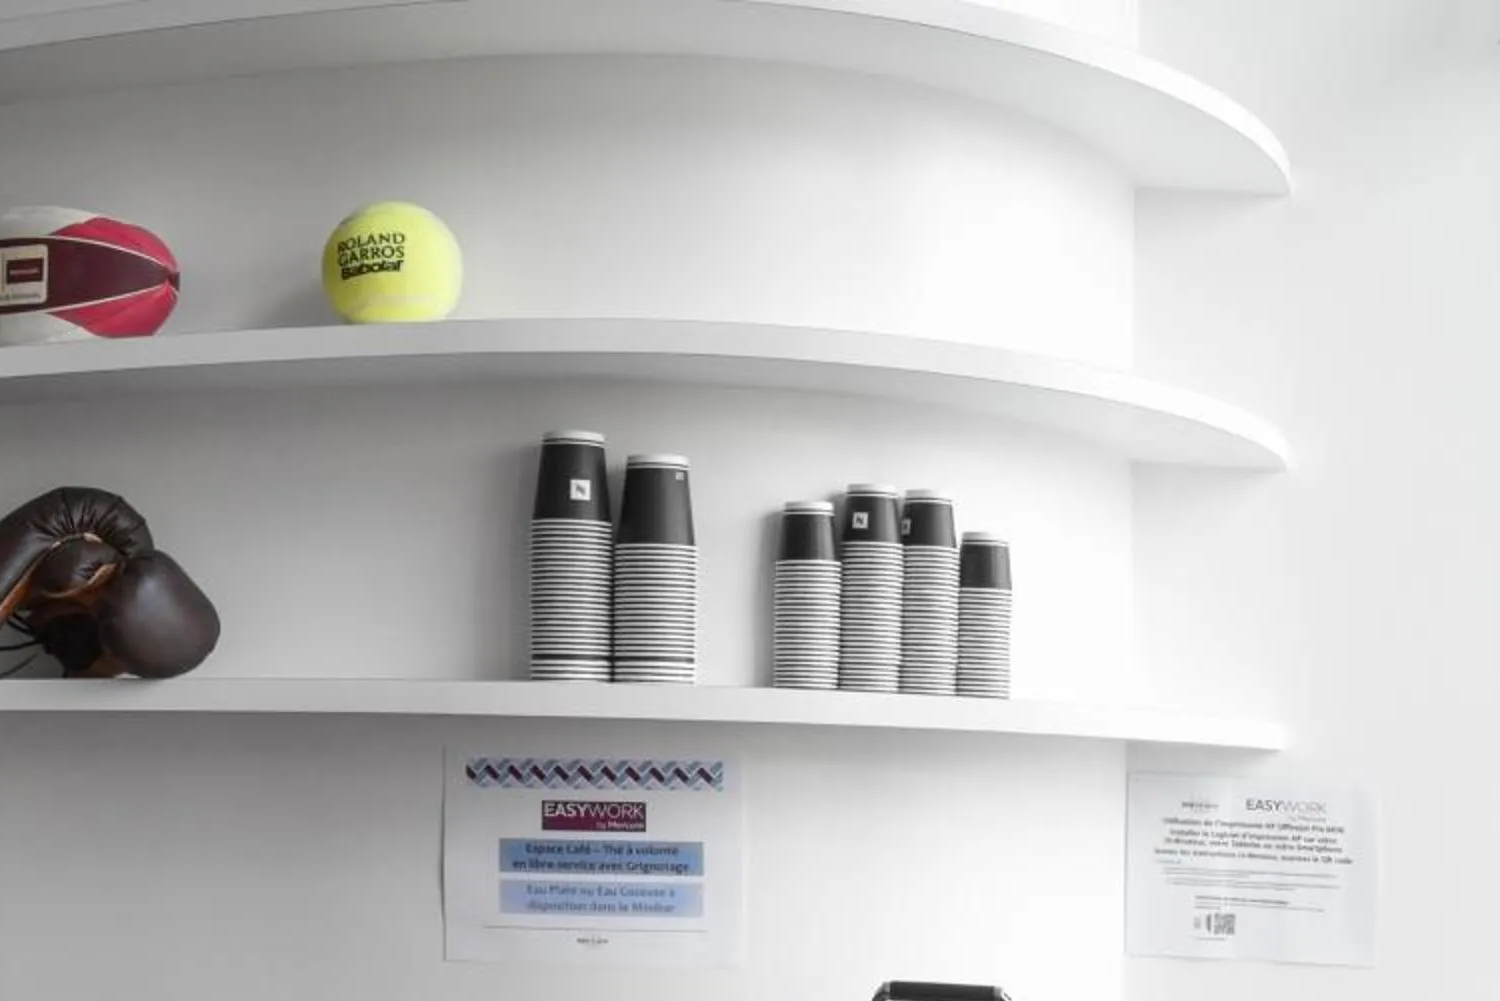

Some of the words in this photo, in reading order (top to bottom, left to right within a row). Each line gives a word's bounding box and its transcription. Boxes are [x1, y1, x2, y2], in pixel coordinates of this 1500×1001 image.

[338, 233, 405, 253] ROLAND
[339, 245, 405, 266] GARROS
[544, 802, 645, 820] EASYWORK
